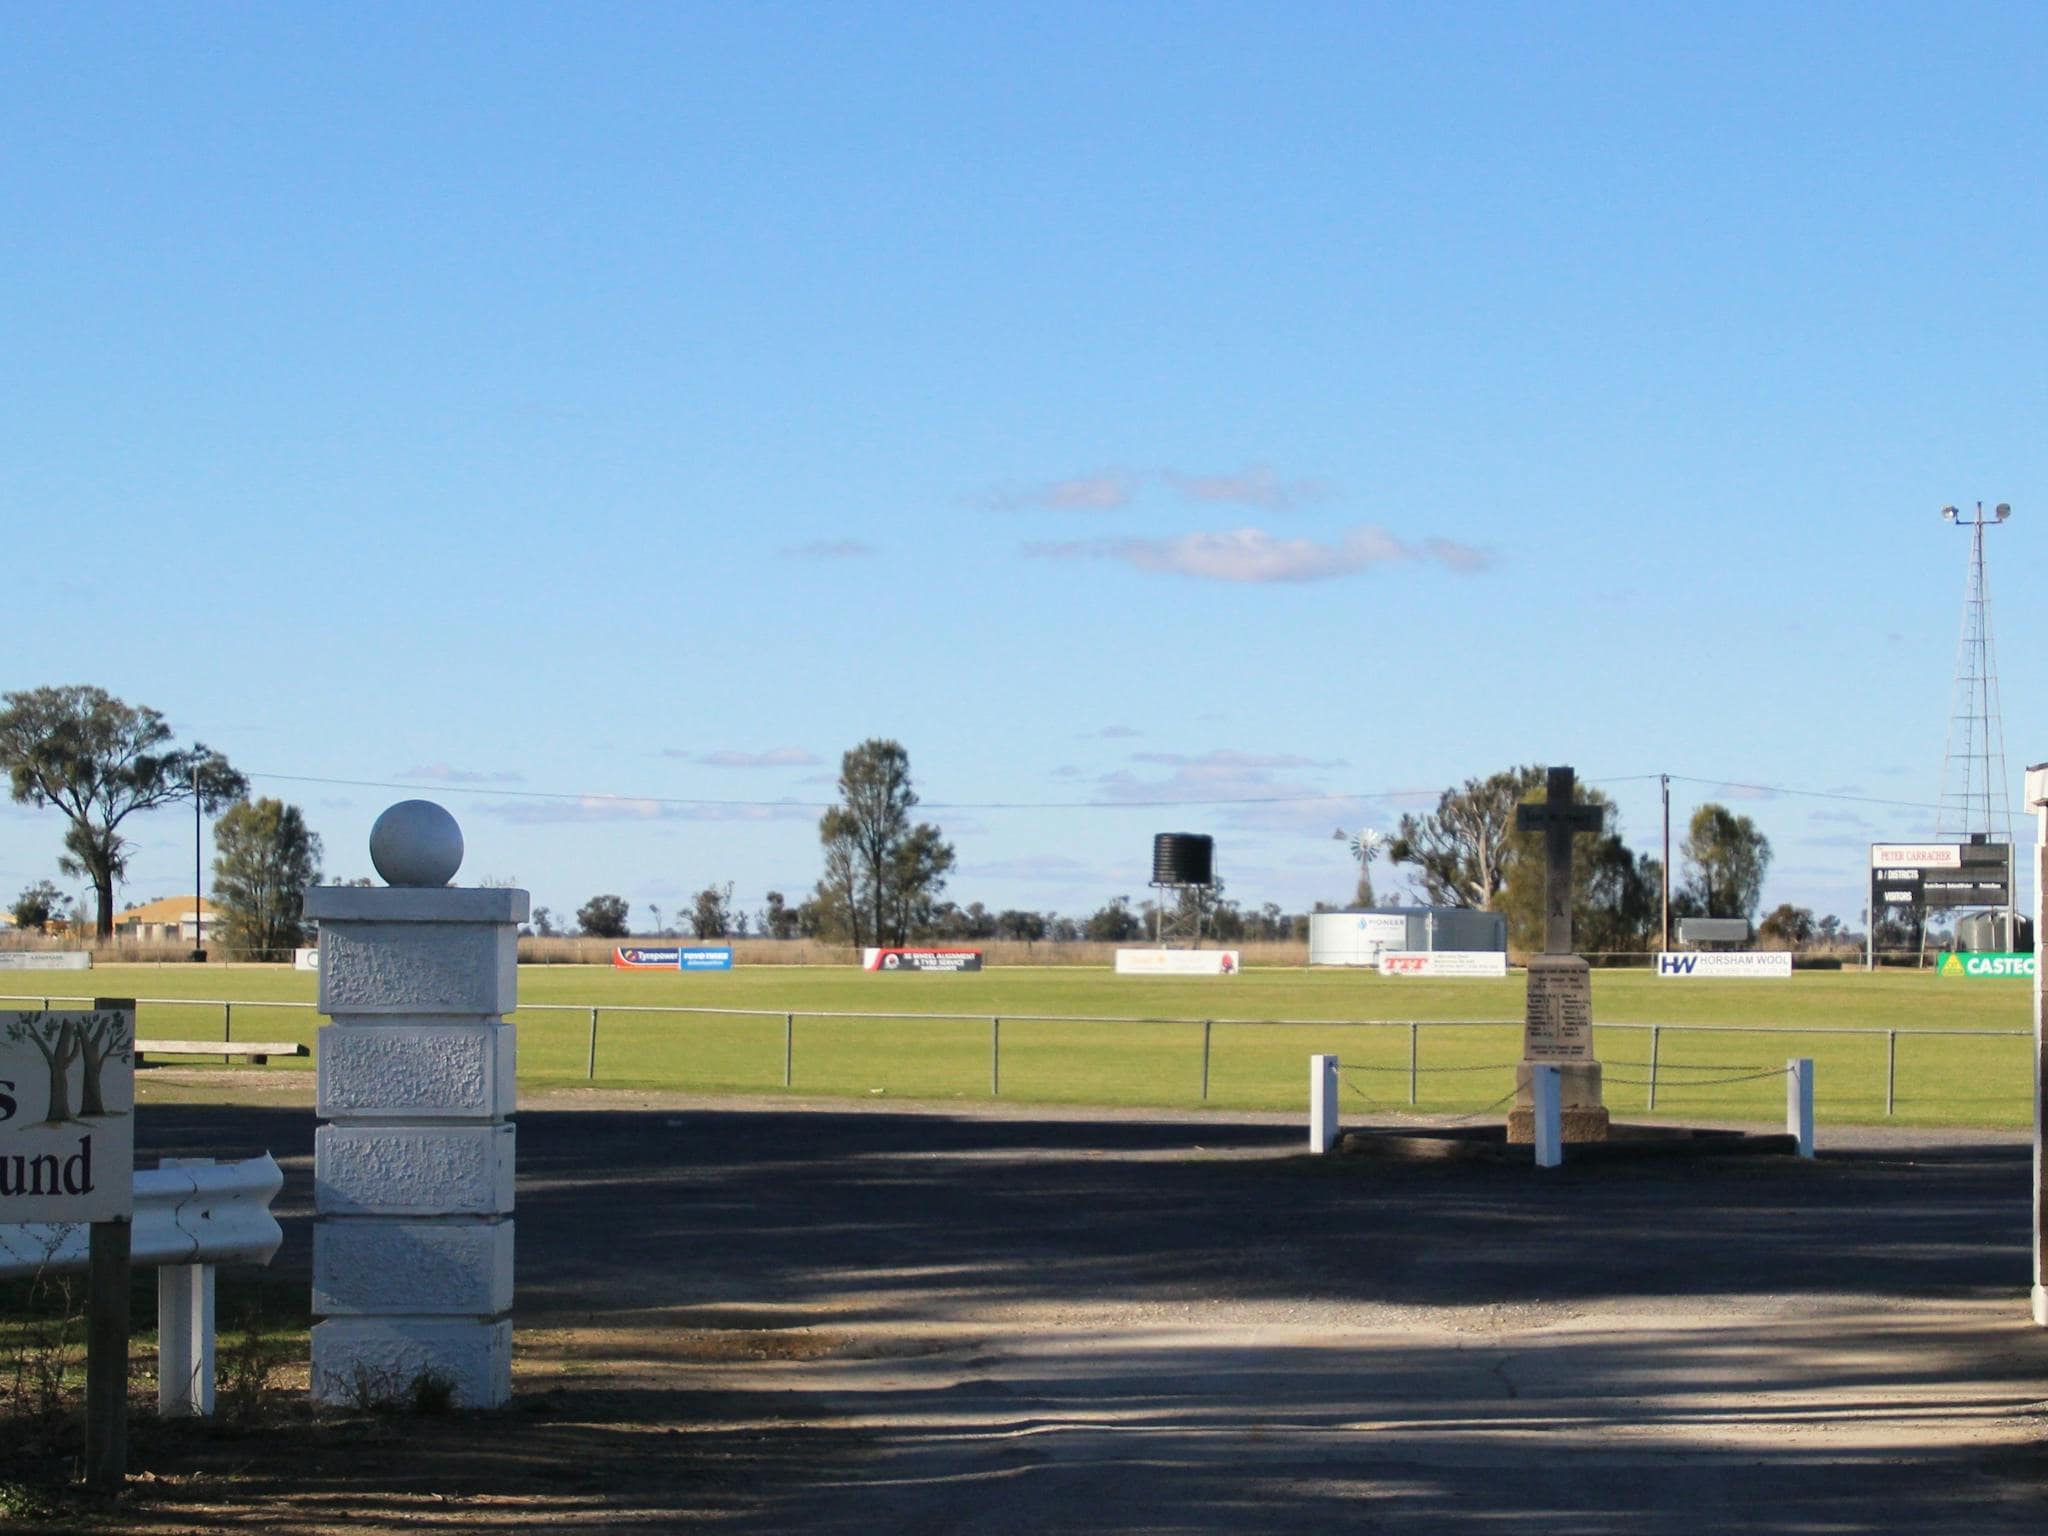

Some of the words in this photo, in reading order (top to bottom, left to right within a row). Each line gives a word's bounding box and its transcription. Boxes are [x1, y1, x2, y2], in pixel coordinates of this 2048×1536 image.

[1880, 851, 1904, 861] PETER
[637, 951, 679, 962] Tyrepower
[1700, 955, 1753, 965] HORSHAM
[1757, 955, 1788, 965] WOOL
[1661, 955, 1697, 973] HW
